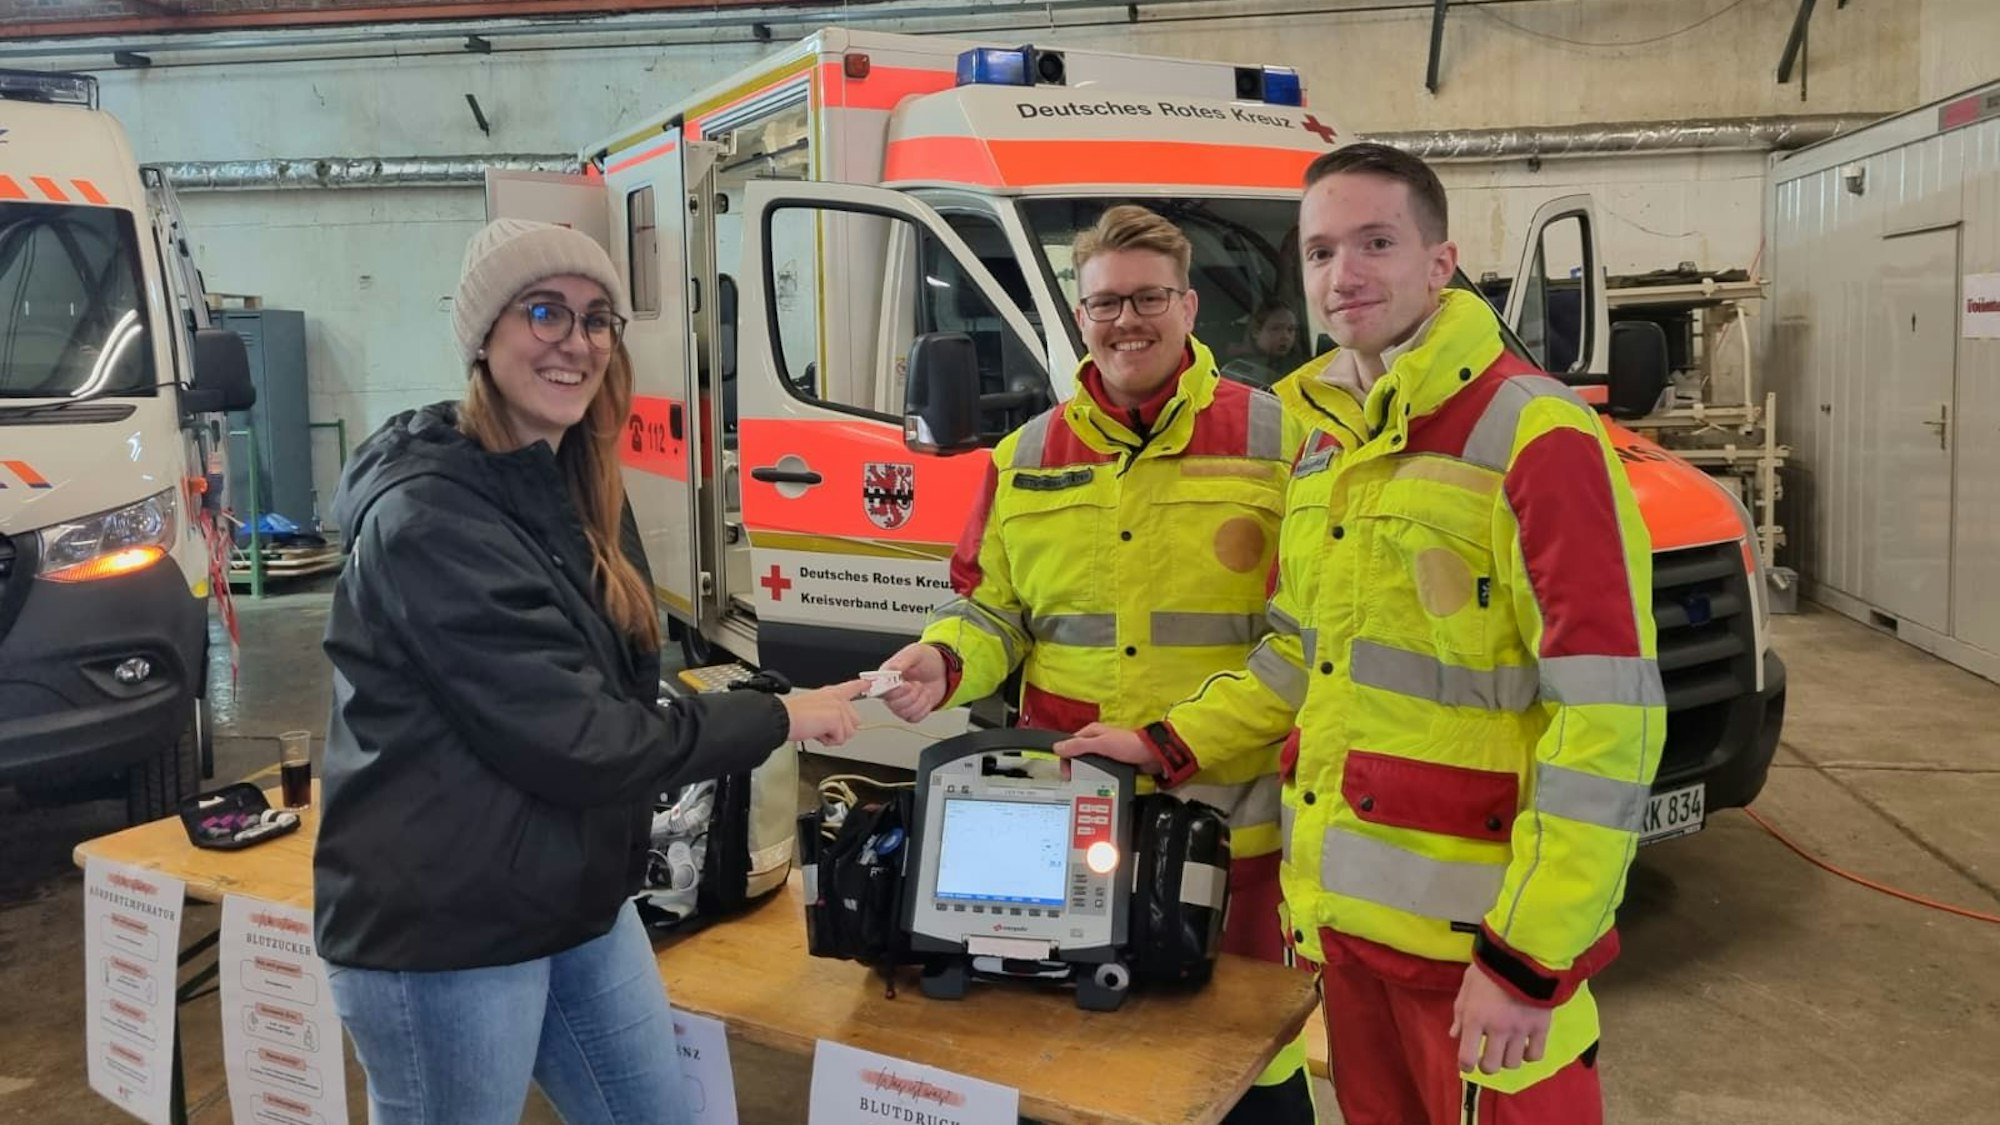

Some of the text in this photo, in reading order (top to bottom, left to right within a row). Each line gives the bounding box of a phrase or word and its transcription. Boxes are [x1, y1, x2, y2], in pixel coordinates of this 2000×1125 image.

[1016, 101, 1296, 130] Deutsches Rotes Kreuz
[648, 422, 666, 454] 112
[800, 567, 869, 584] Deutsches
[873, 573, 912, 587] Rotes
[801, 593, 888, 612] Kreisverband
[1667, 789, 1701, 825] 834
[860, 1097, 960, 1125] BLUTDRU
